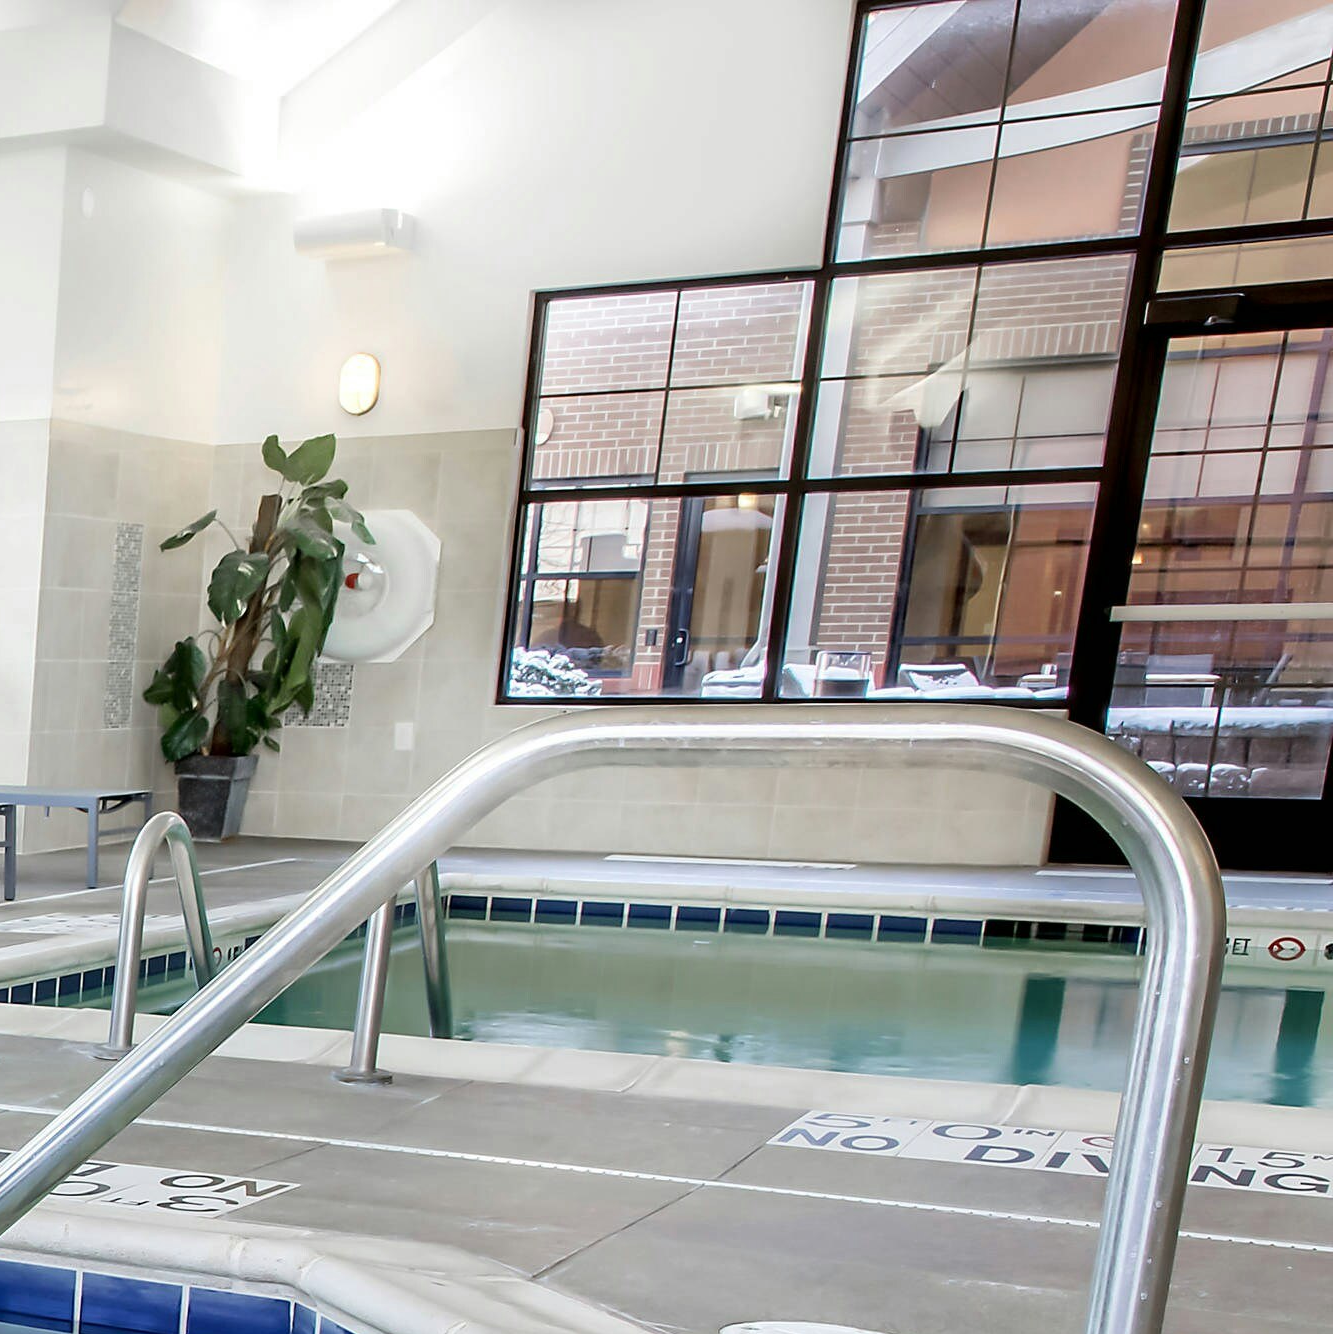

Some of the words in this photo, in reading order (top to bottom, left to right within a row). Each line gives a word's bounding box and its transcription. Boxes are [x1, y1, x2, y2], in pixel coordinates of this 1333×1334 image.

[778, 1128, 899, 1151] NO
[963, 1144, 1330, 1193] DING
[159, 1175, 290, 1197] NO
